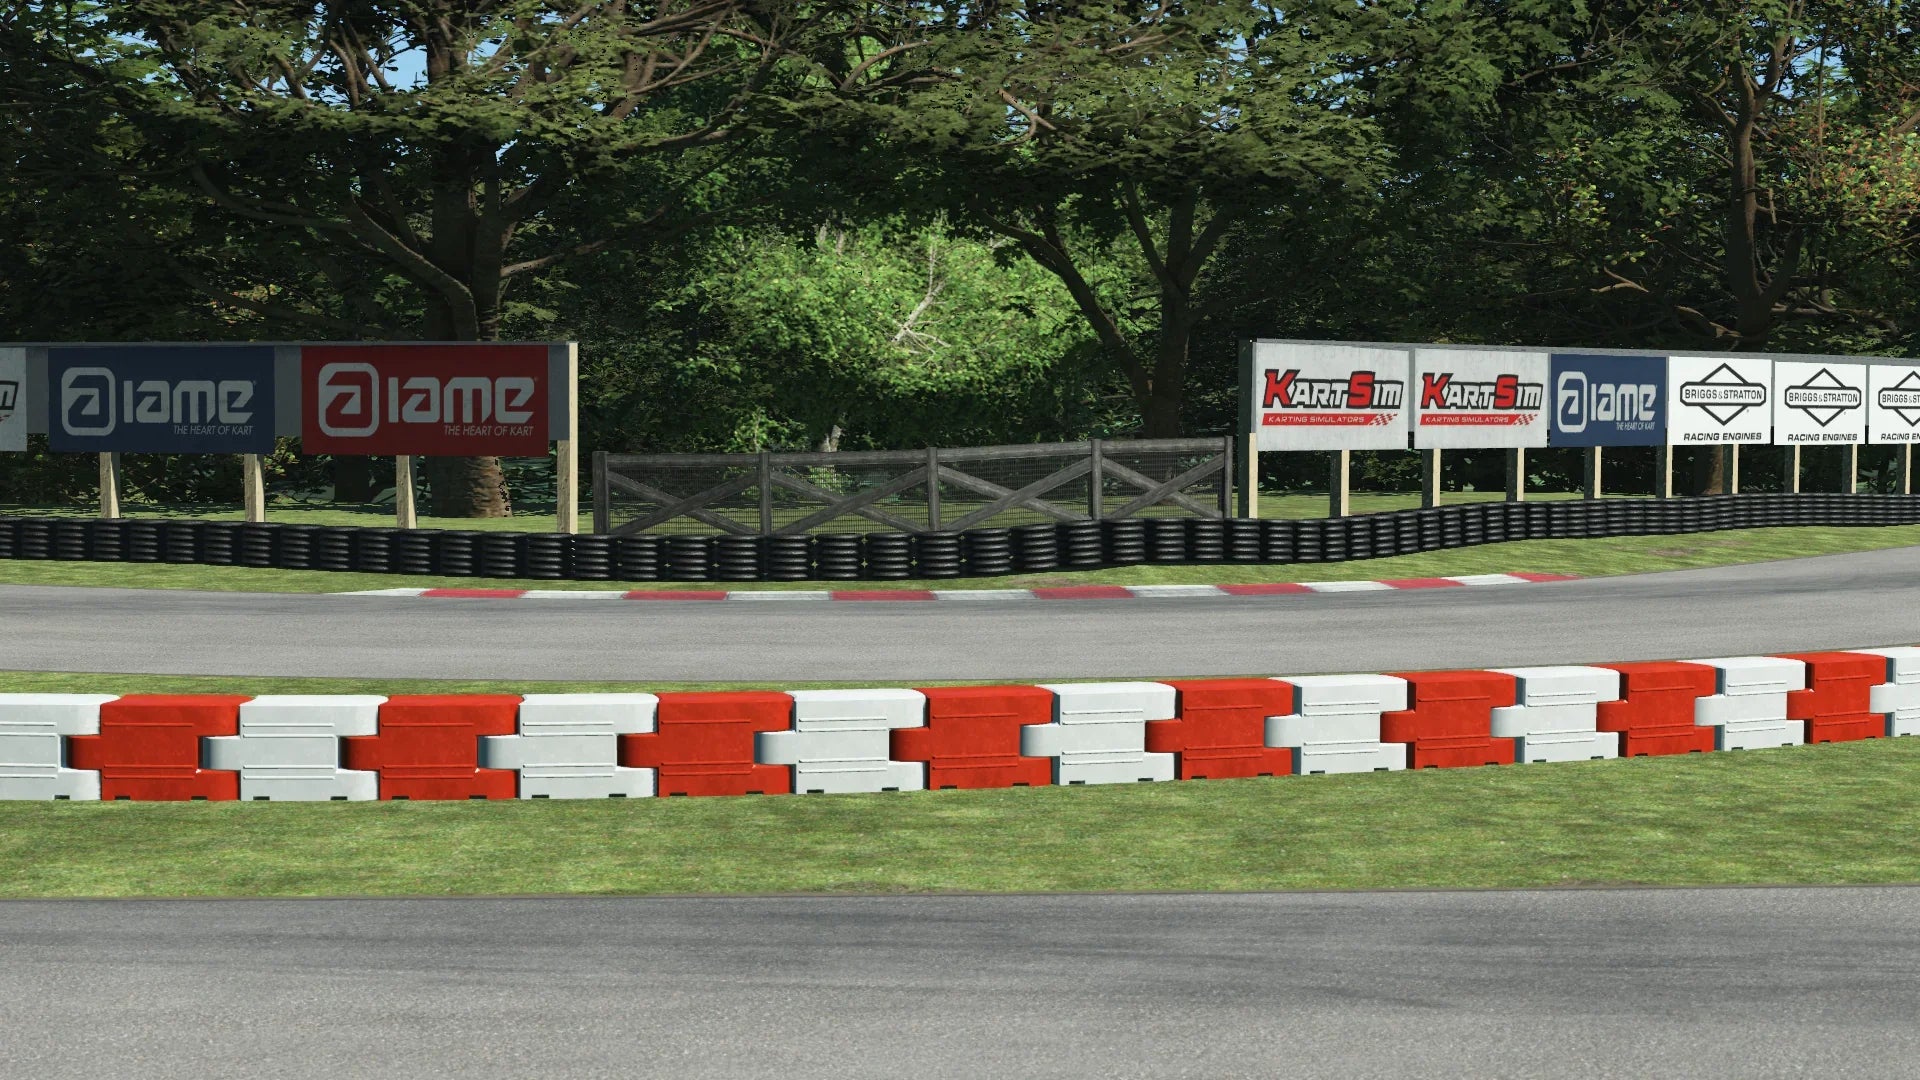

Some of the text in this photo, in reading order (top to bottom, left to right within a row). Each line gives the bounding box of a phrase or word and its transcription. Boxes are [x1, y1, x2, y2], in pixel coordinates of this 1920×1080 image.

[174, 425, 253, 435] THE HEART OF KART
[444, 425, 534, 436] THE HEART OF KART
[1684, 432, 1762, 441] RACING ENGINES
[1822, 433, 1858, 441] ENGINES
[1881, 433, 1910, 441] RACING
